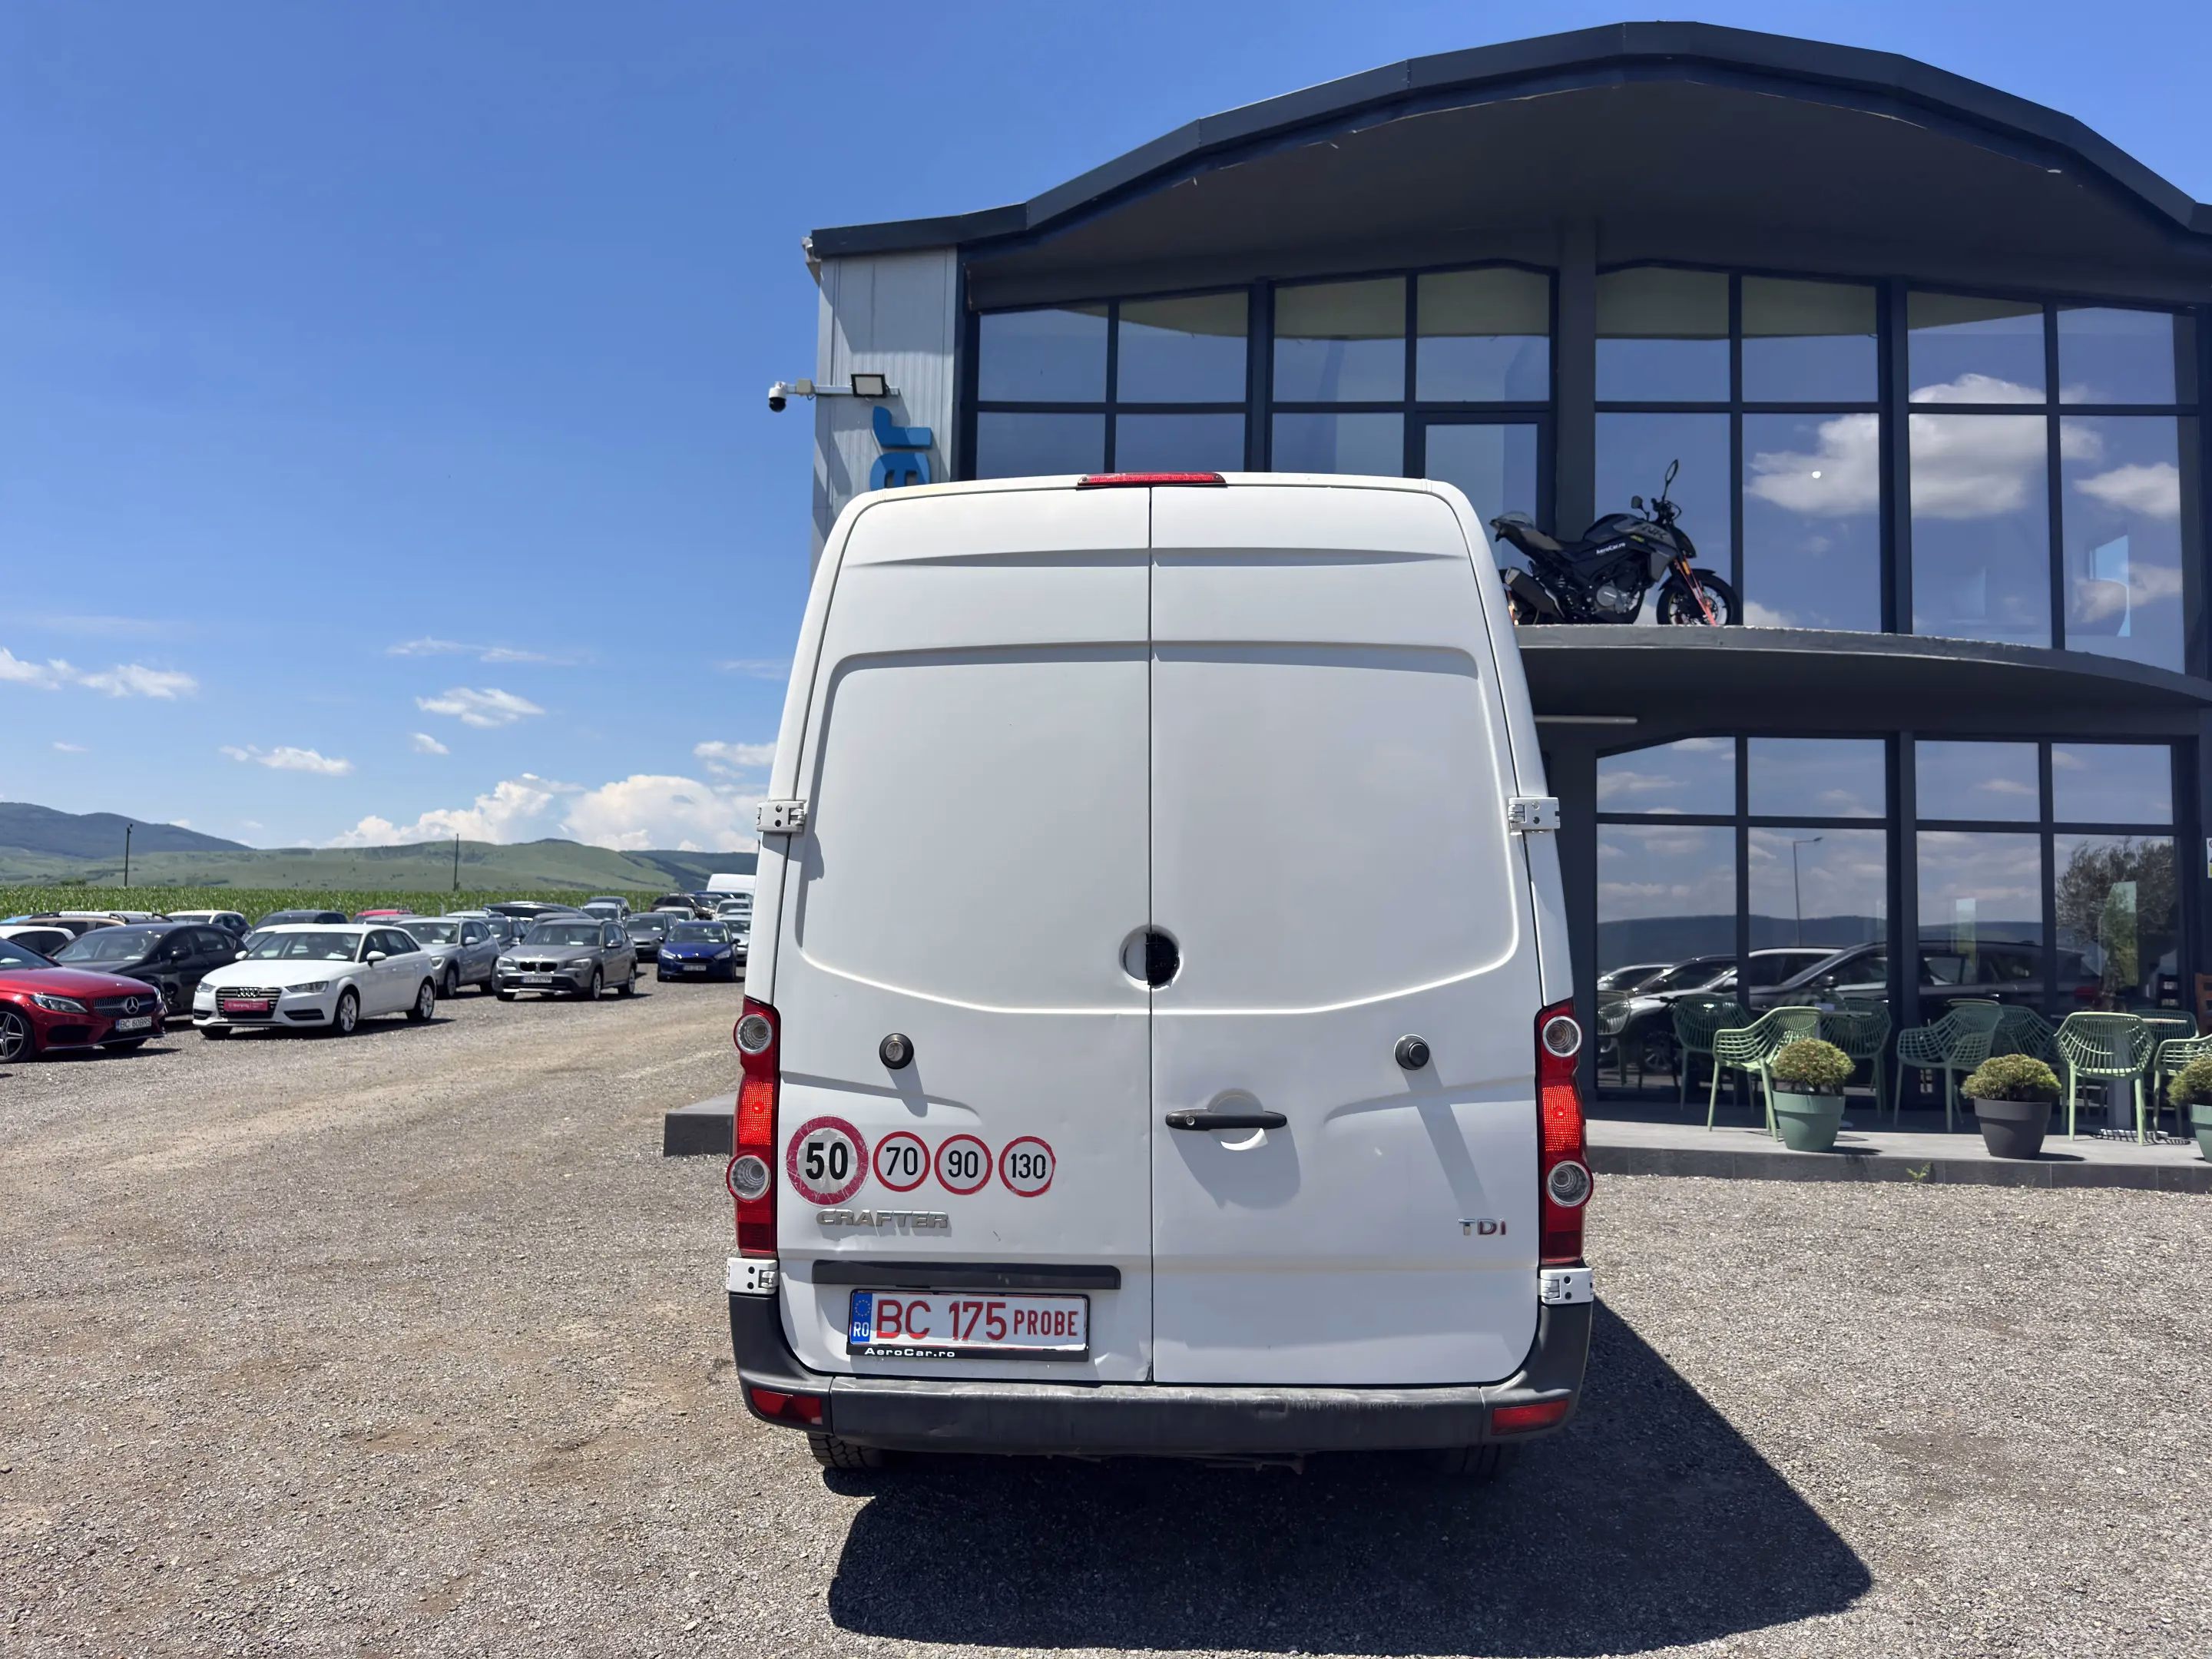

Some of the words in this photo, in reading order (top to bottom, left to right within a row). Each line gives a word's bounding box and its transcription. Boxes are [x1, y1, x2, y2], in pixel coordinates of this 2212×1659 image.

[805, 1142, 848, 1180] 50
[886, 1147, 919, 1177] 70
[948, 1150, 979, 1178] 90
[1010, 1153, 1047, 1179] 130
[816, 1208, 949, 1229] CRAFTER
[853, 1321, 869, 1337] RO
[876, 1299, 931, 1340] BC
[949, 1300, 1007, 1342] 175
[1013, 1309, 1078, 1336] PROBE
[864, 1347, 955, 1358] AeroCar.ro
